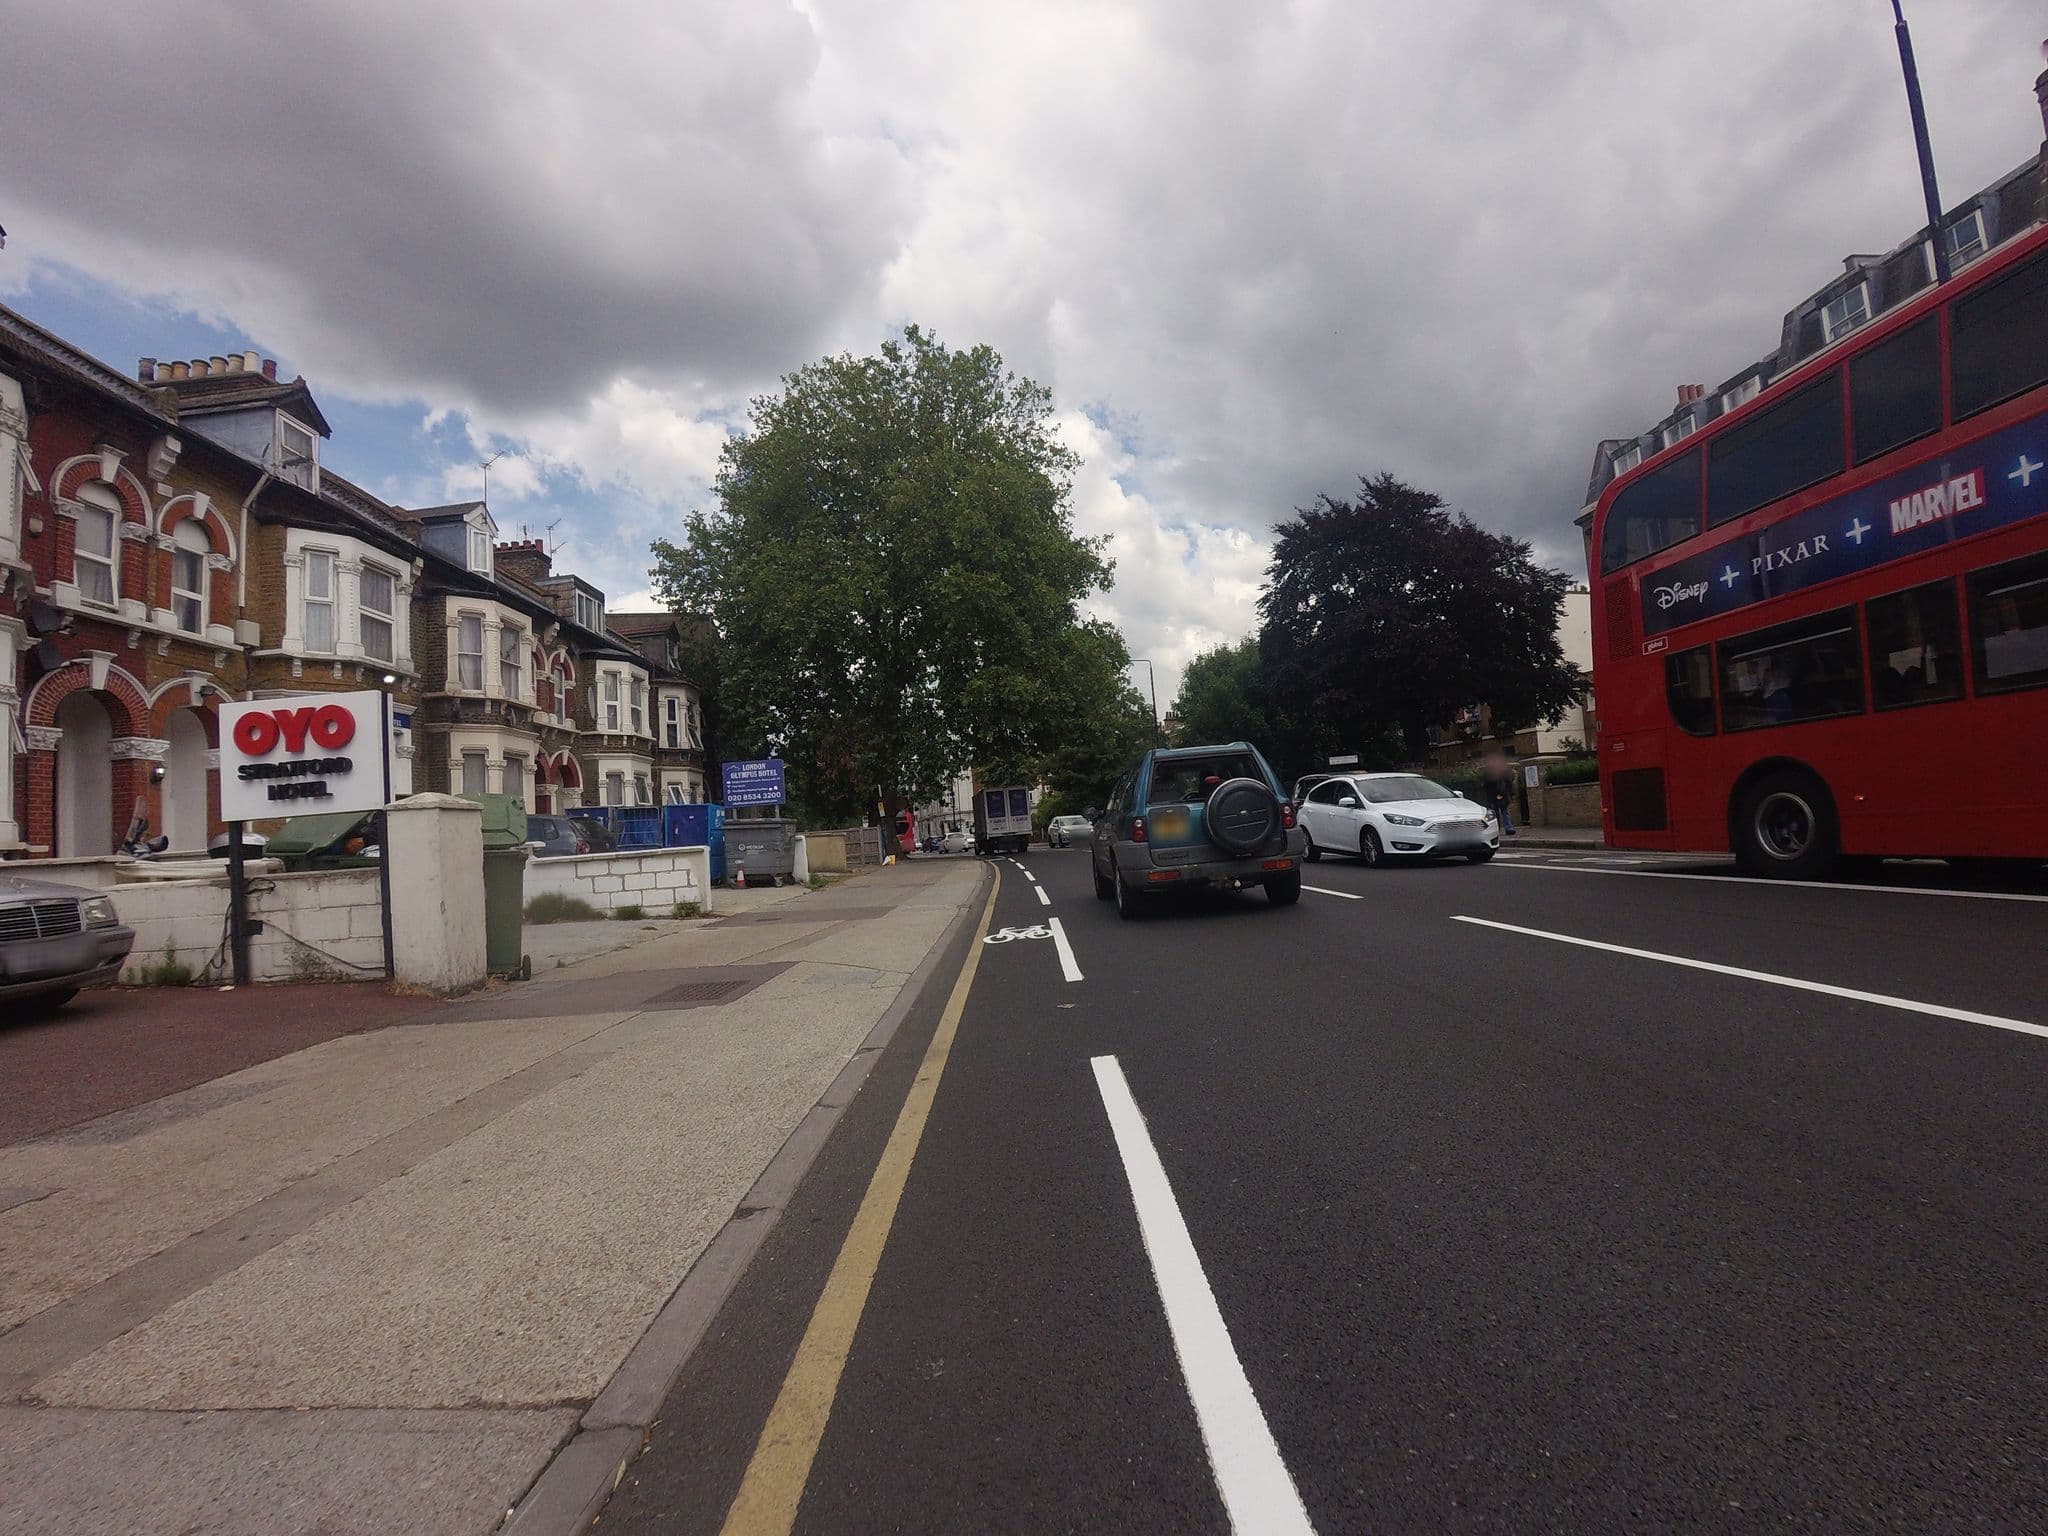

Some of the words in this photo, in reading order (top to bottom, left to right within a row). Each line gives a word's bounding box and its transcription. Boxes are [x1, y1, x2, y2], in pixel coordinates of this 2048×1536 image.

[1751, 534, 1830, 576] PIXAR
[1890, 473, 1983, 534] MARVEL
[233, 704, 356, 757] OYO
[730, 770, 758, 779] OLYMPUS
[758, 769, 778, 777] HOTEL
[742, 763, 766, 771] LONDON
[268, 781, 334, 800] HOTEL
[762, 791, 782, 799] 3200
